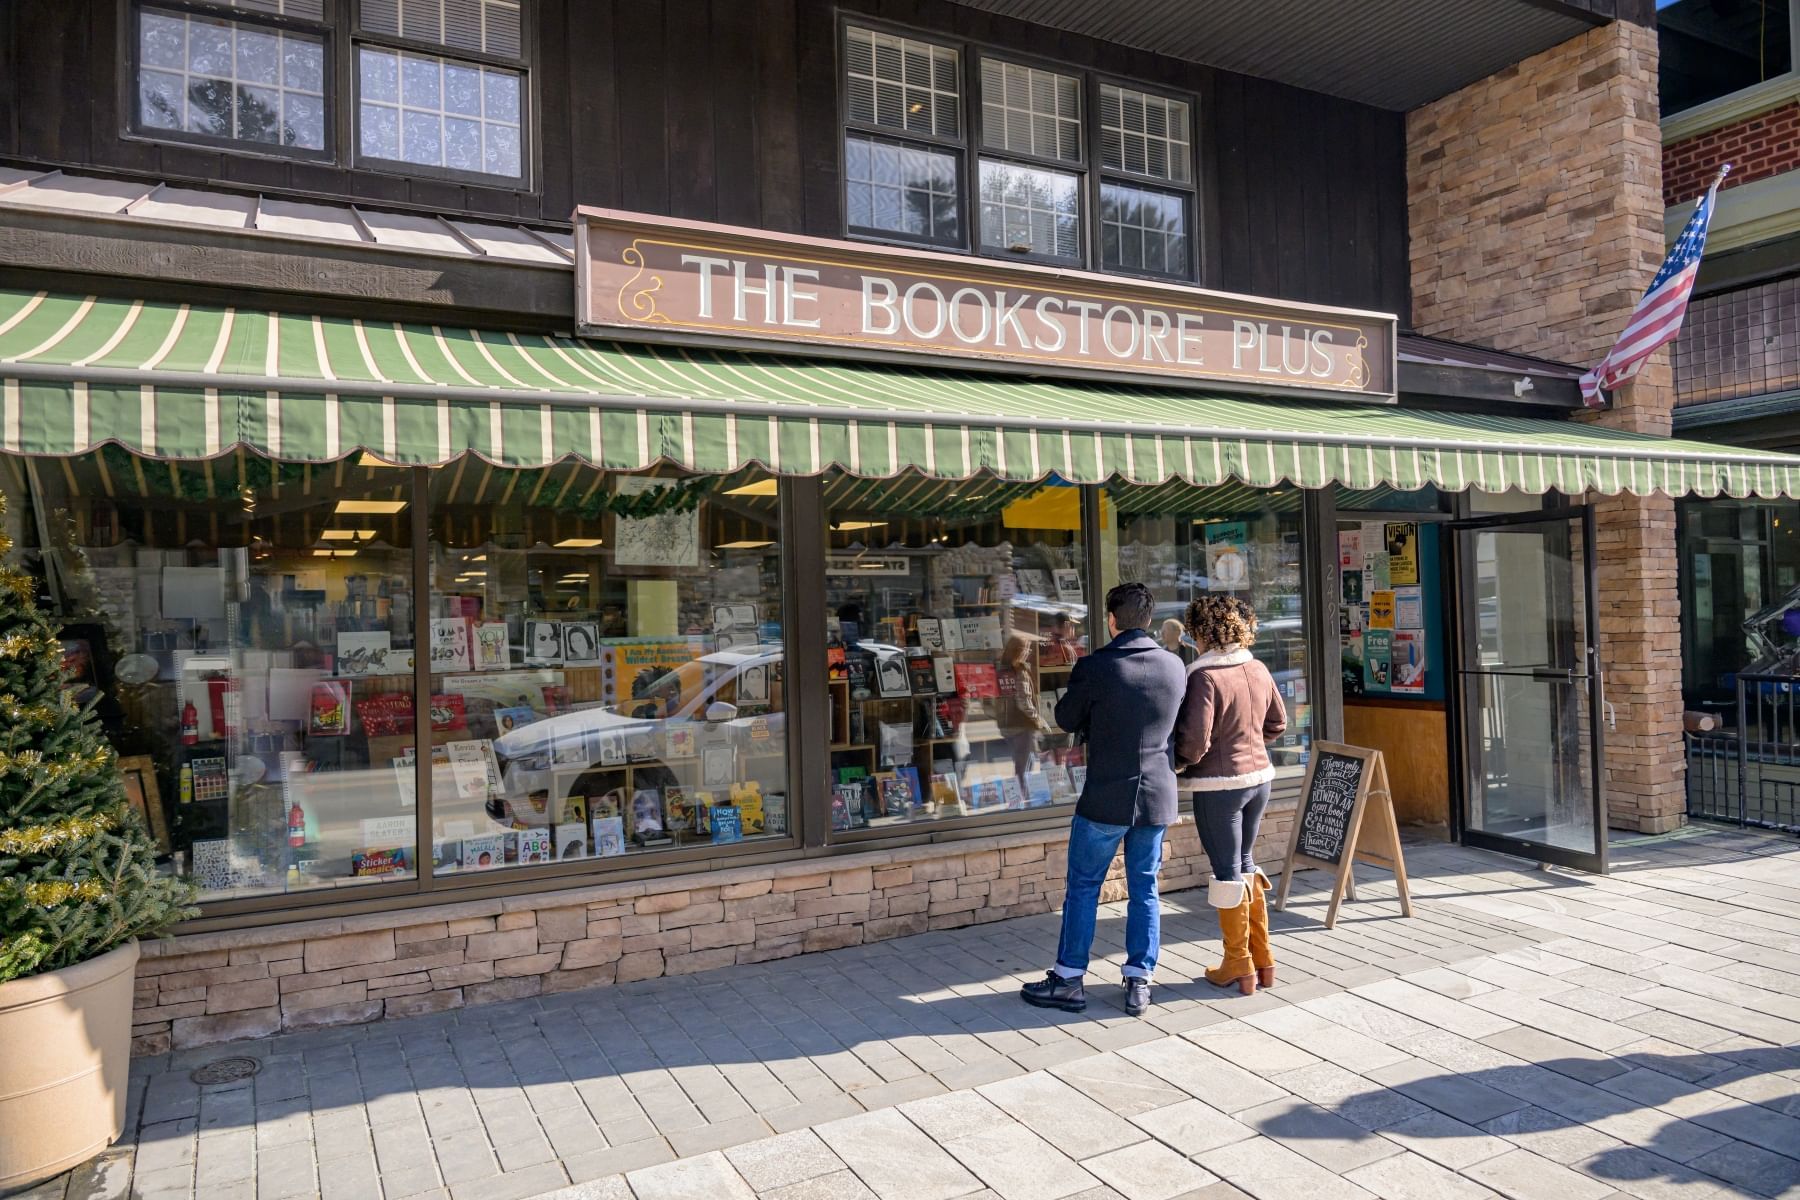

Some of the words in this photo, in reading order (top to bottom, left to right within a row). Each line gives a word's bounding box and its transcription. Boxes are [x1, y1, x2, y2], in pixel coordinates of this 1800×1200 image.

[681, 254, 821, 329] THE
[860, 275, 1204, 365] BOOKSTORE
[1232, 319, 1336, 378] PLUS
[1387, 523, 1415, 538] VISION
[1326, 563, 1336, 638] 2491
[477, 630, 505, 641] YOU
[1367, 635, 1389, 645] Free
[1345, 760, 1361, 778] only
[1312, 789, 1342, 805] BETWEEN
[1339, 797, 1354, 811] AN
[522, 840, 548, 853] ABC
[1307, 832, 1331, 850] heart
[470, 843, 496, 854] MALALA
[358, 864, 396, 876] Mosaics
[360, 857, 393, 869] Sticker
